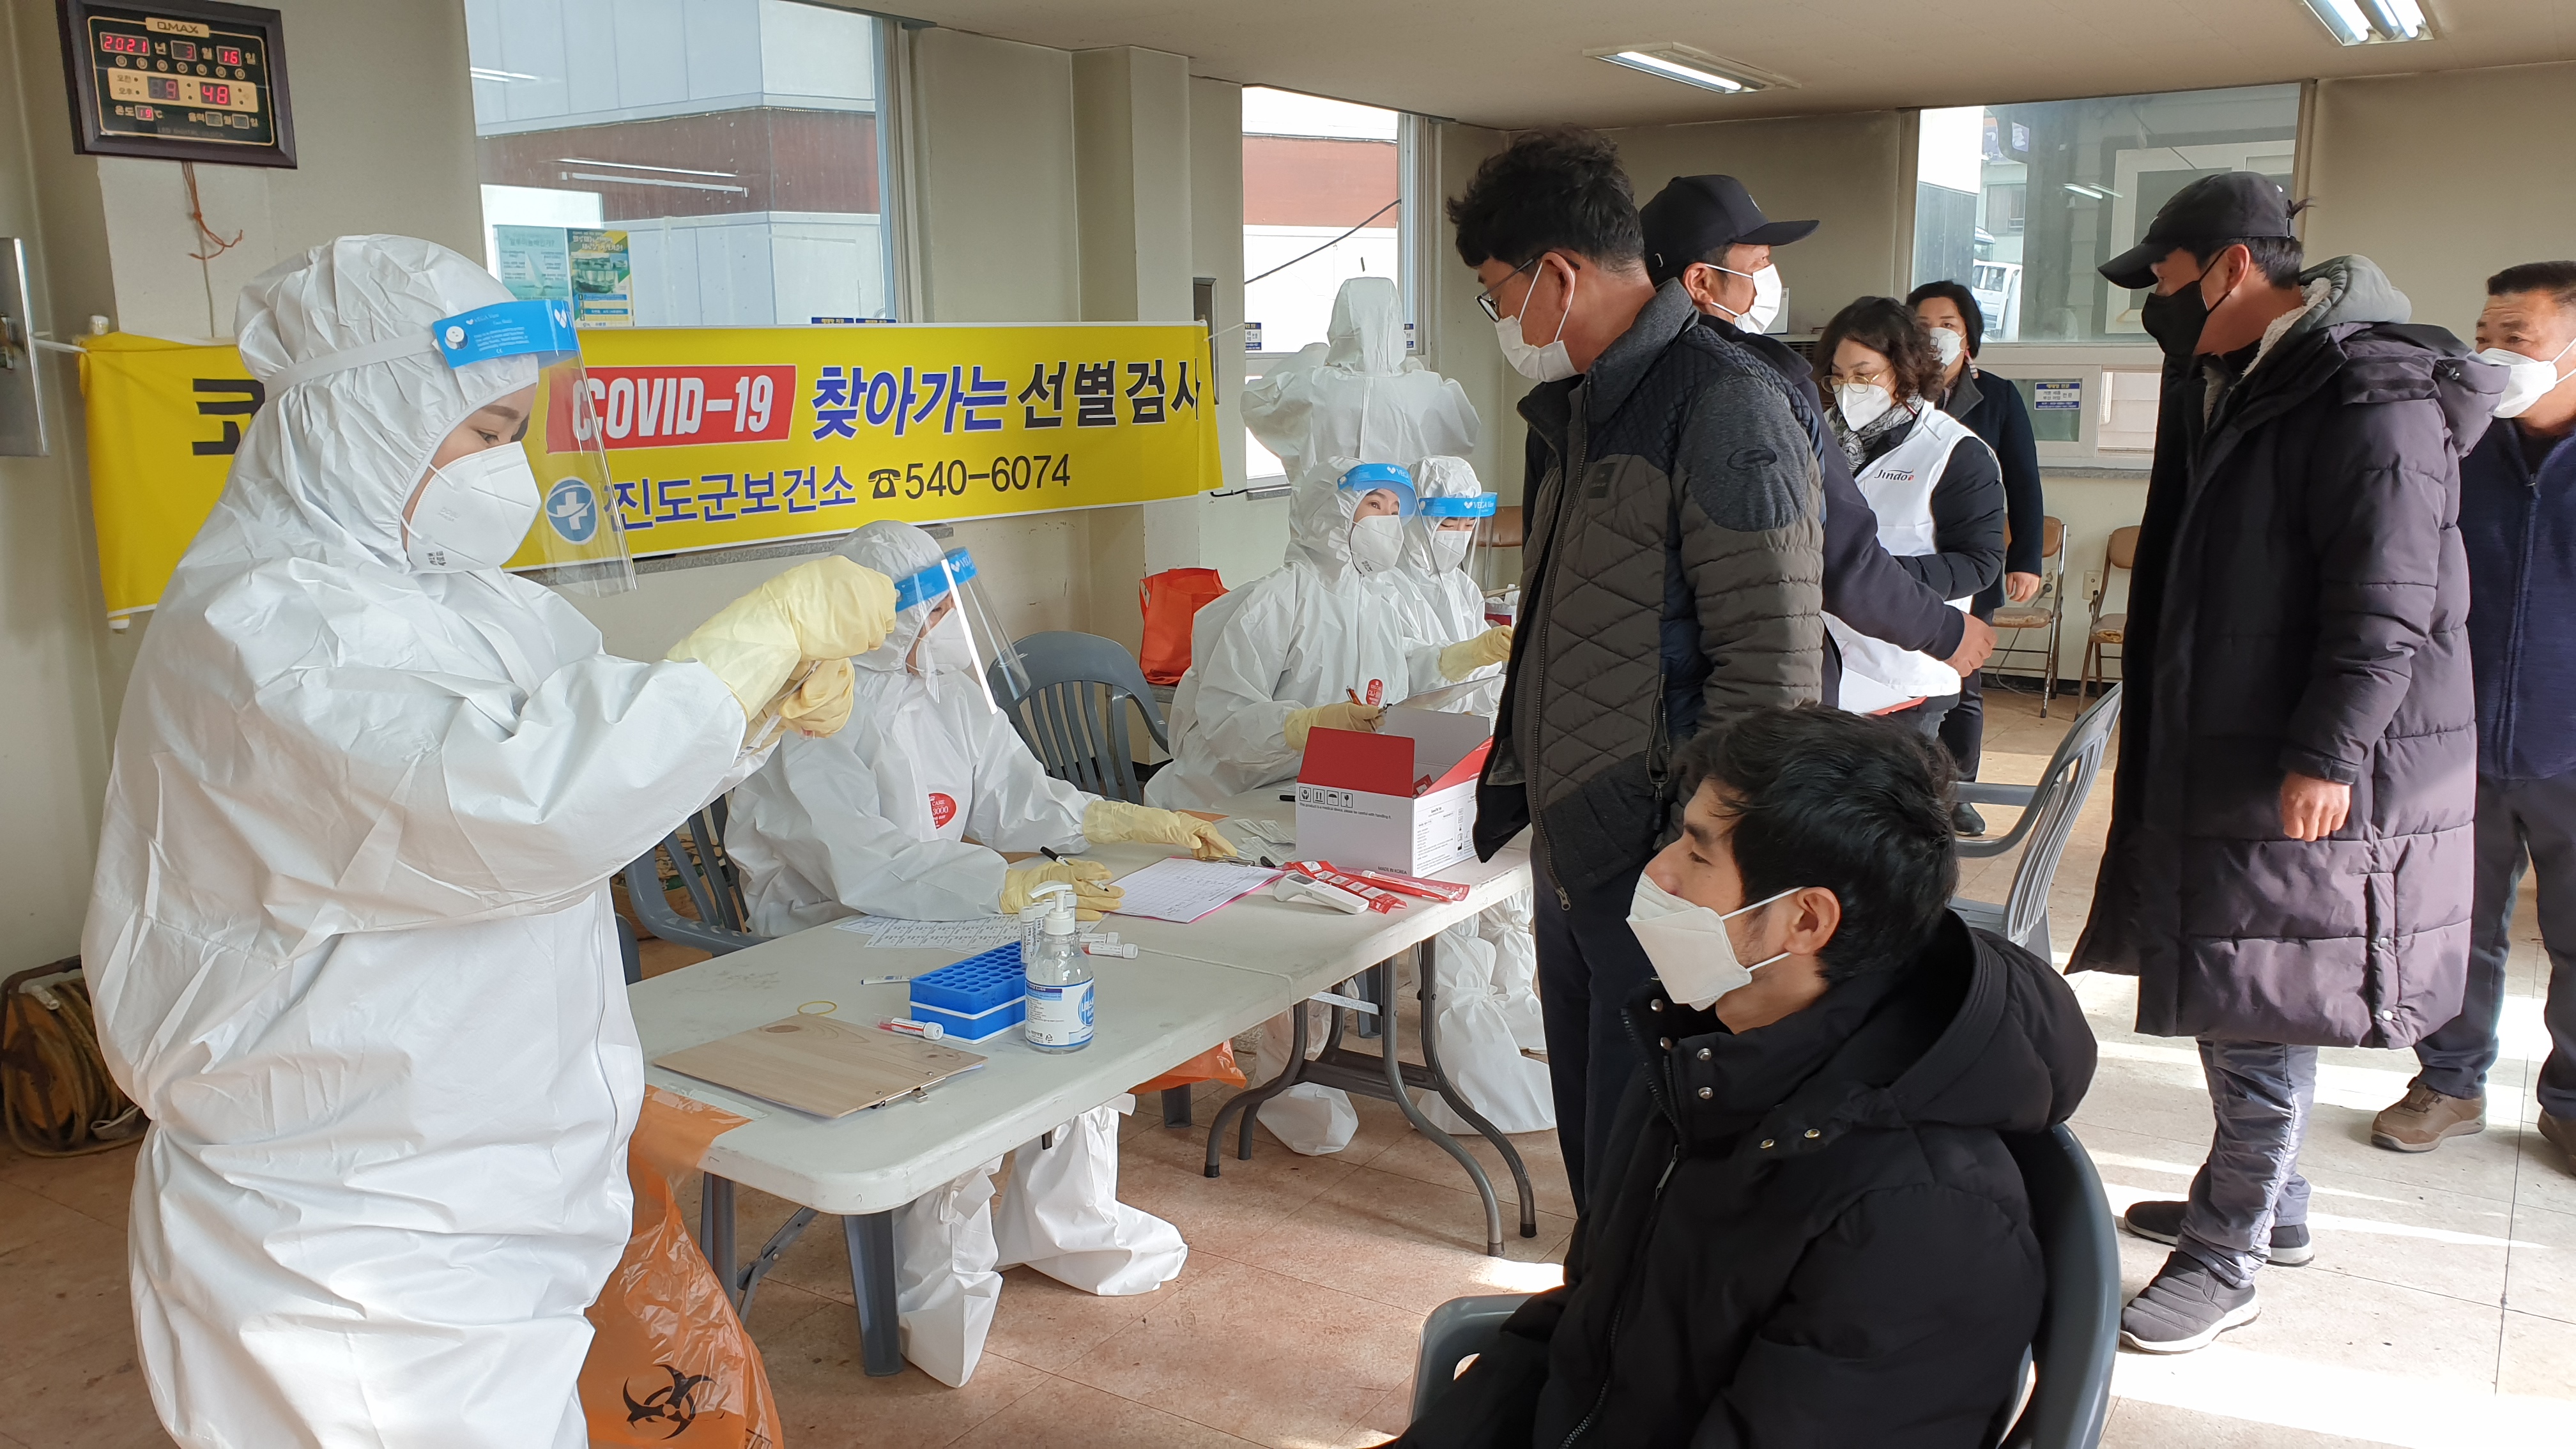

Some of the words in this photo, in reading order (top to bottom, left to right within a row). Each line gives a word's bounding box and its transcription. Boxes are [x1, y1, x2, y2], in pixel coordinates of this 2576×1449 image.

[157, 21, 199, 34] QMAX
[104, 35, 148, 52] 2021
[155, 42, 167, 55] 년
[186, 46, 193, 59] 3
[224, 50, 238, 65] 16
[166, 80, 177, 99] 9
[203, 85, 229, 105] 48
[140, 109, 152, 118] 19
[572, 375, 774, 441] COVID-19
[811, 365, 1008, 441] 찾아가는
[1017, 358, 1201, 429] 선별검사
[1874, 469, 1908, 481] Jindo
[603, 466, 857, 532] 진도군보건소
[905, 454, 1071, 500] 540-6074
[933, 806, 949, 816] 3000
